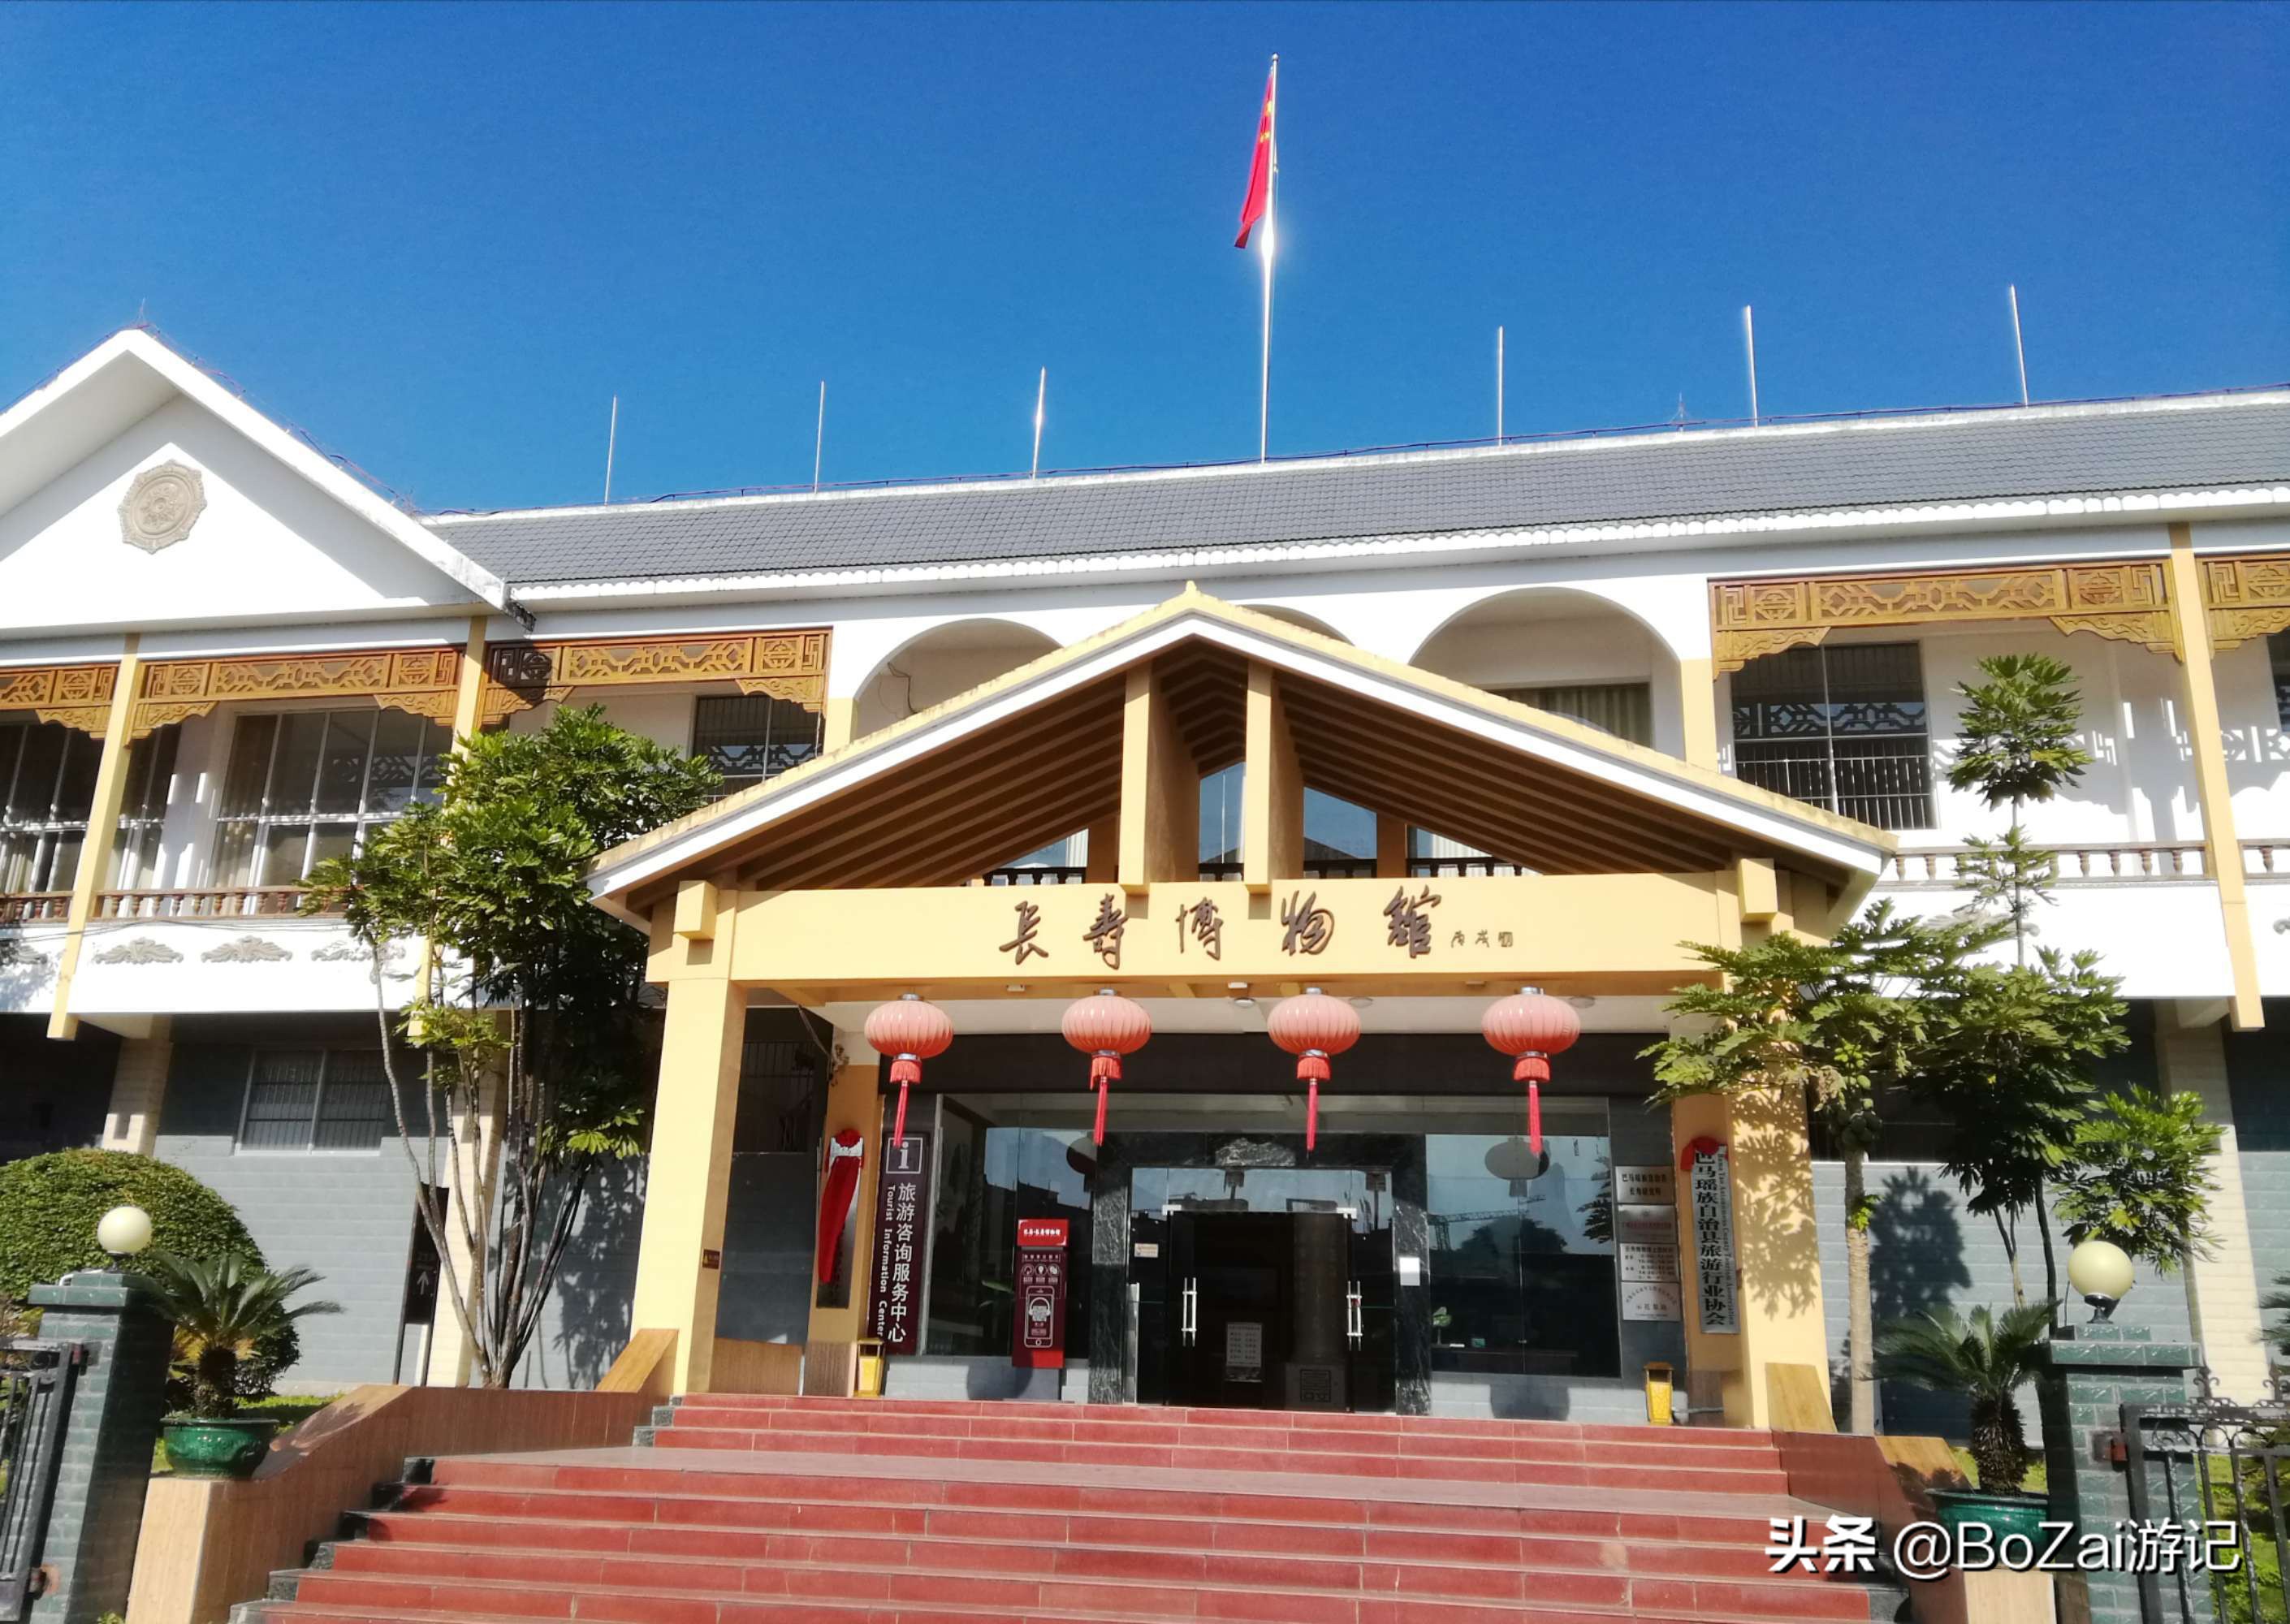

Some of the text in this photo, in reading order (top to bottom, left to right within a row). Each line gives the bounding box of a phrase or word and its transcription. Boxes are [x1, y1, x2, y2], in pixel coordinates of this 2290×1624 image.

[877, 1185, 896, 1337] Tourist Information Center
[888, 1182, 917, 1343] 旅游咨询服务中心
[1695, 1151, 1726, 1325] 巴马瑶族自治县旅游行业协会
